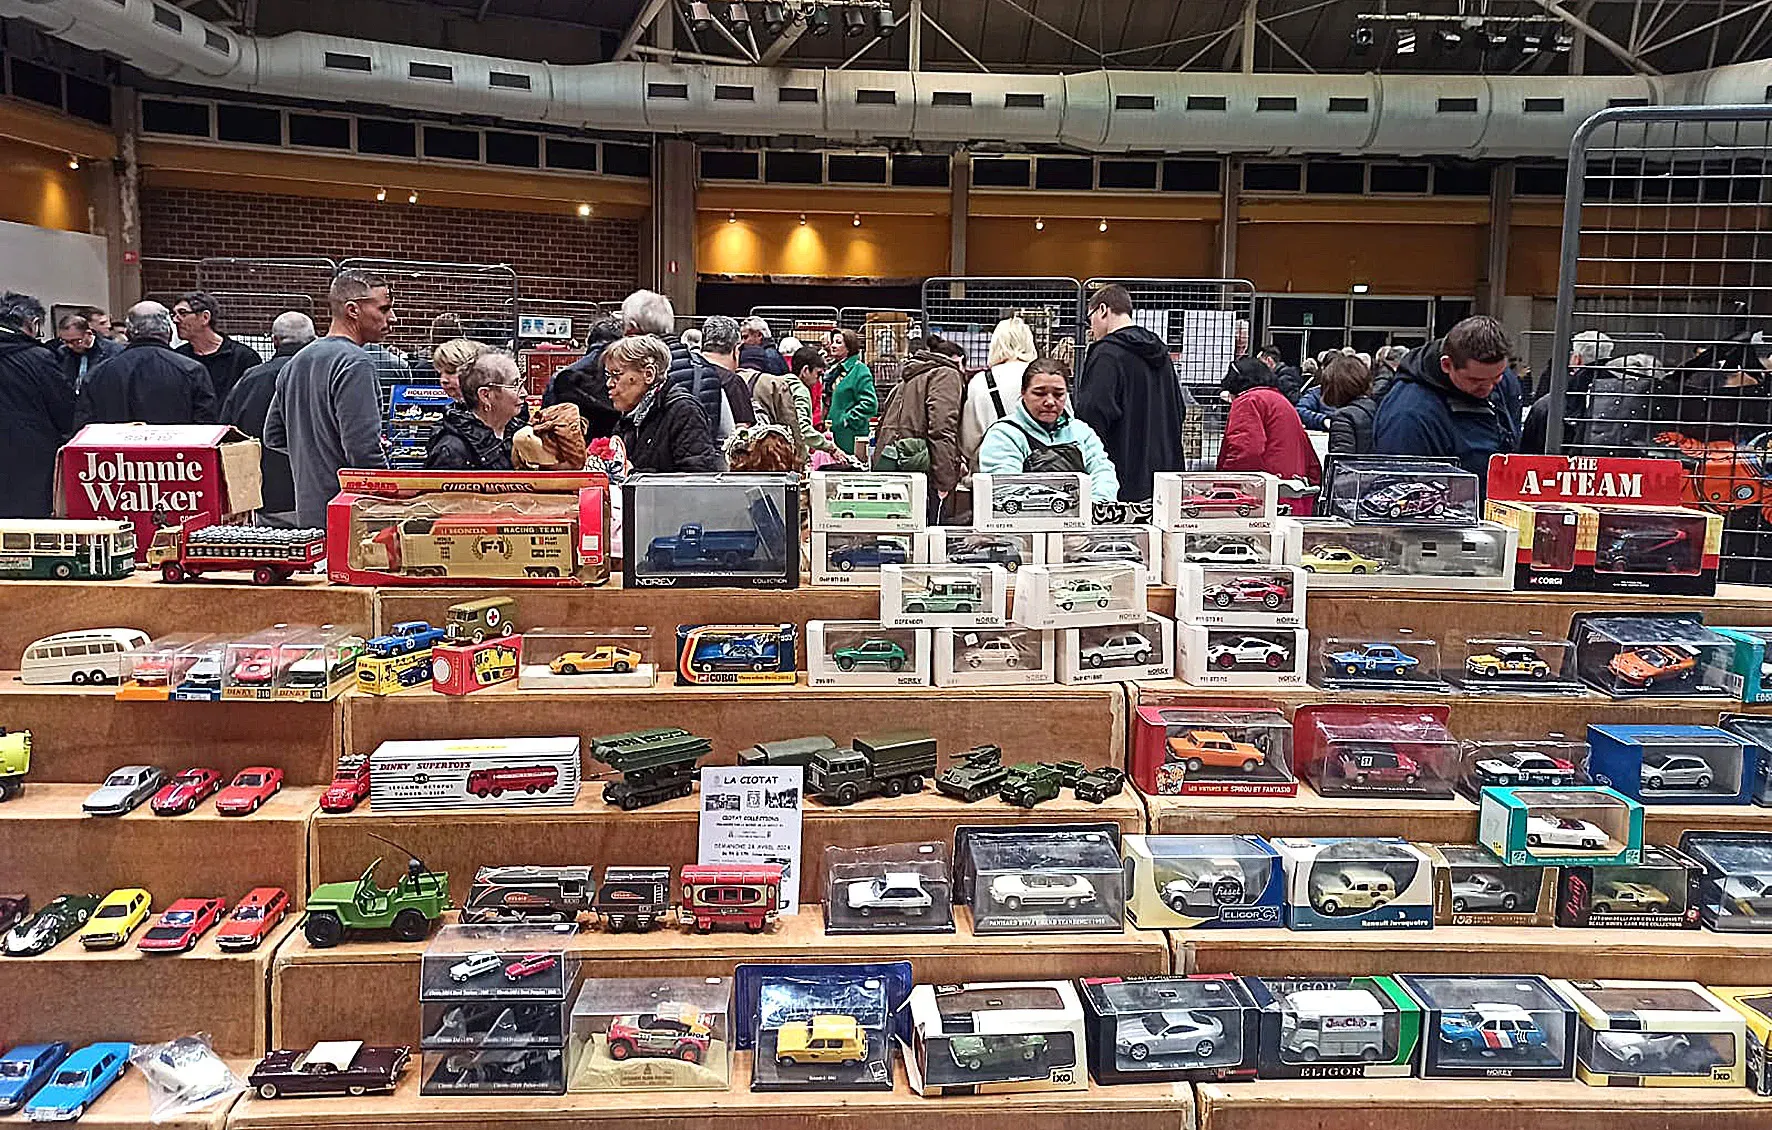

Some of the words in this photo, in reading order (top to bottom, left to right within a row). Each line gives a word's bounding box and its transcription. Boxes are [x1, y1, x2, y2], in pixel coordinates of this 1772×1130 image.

[78, 452, 204, 482] Johnnie
[1568, 458, 1598, 471] THE
[1519, 470, 1643, 498] A-TEAM
[81, 482, 204, 512] Walker
[503, 526, 535, 534] RACING
[635, 577, 677, 586] NOREV
[1538, 577, 1563, 585] CORGI
[709, 673, 738, 682] CORGI
[379, 763, 411, 771] DINKY
[416, 761, 472, 770] SUPERTOYS
[724, 776, 737, 785] LA
[740, 776, 779, 784] CIOTAT
[1230, 785, 1253, 793] SPIROU
[1224, 911, 1260, 919] ELIGOR
[1300, 1067, 1361, 1077] ELIGOR
[1486, 1069, 1513, 1077] NOREV
[1713, 1070, 1730, 1080] ixo
[1052, 1071, 1070, 1083] ixo
